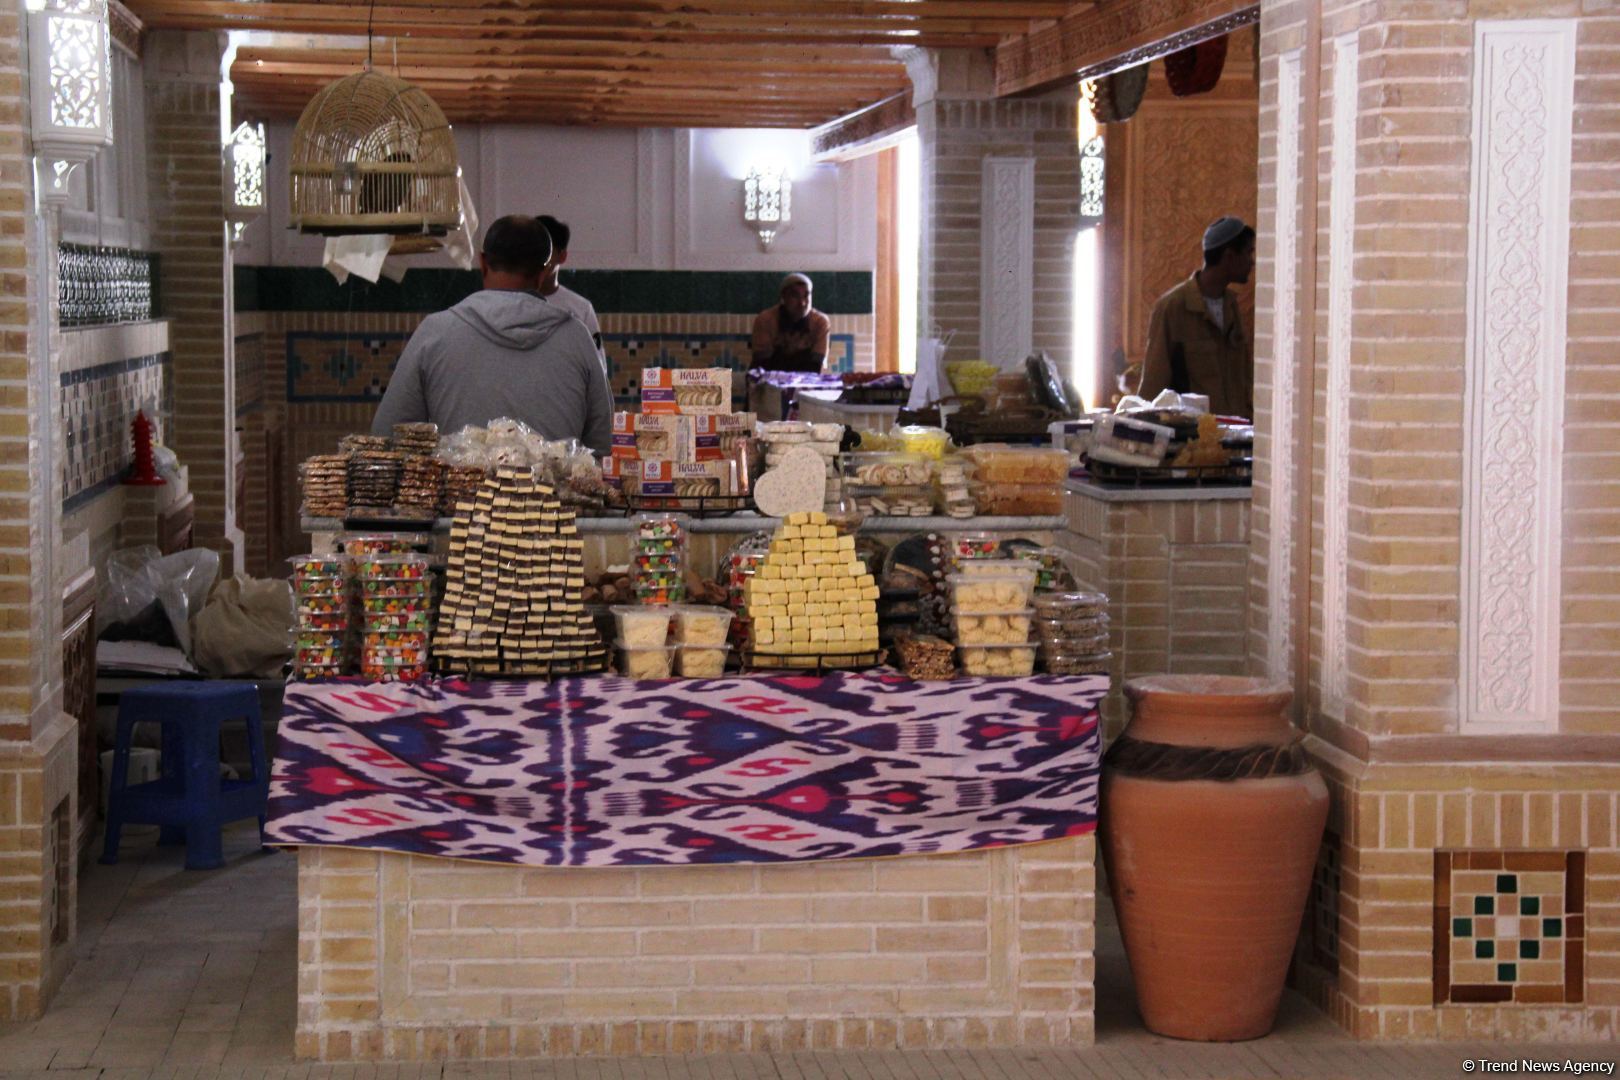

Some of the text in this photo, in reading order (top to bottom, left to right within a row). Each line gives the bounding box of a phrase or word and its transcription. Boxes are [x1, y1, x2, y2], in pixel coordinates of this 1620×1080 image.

[680, 371, 707, 380] HALVA
[639, 416, 659, 425] HALVA
[720, 416, 740, 425] HALVA
[679, 463, 705, 473] HALVA
